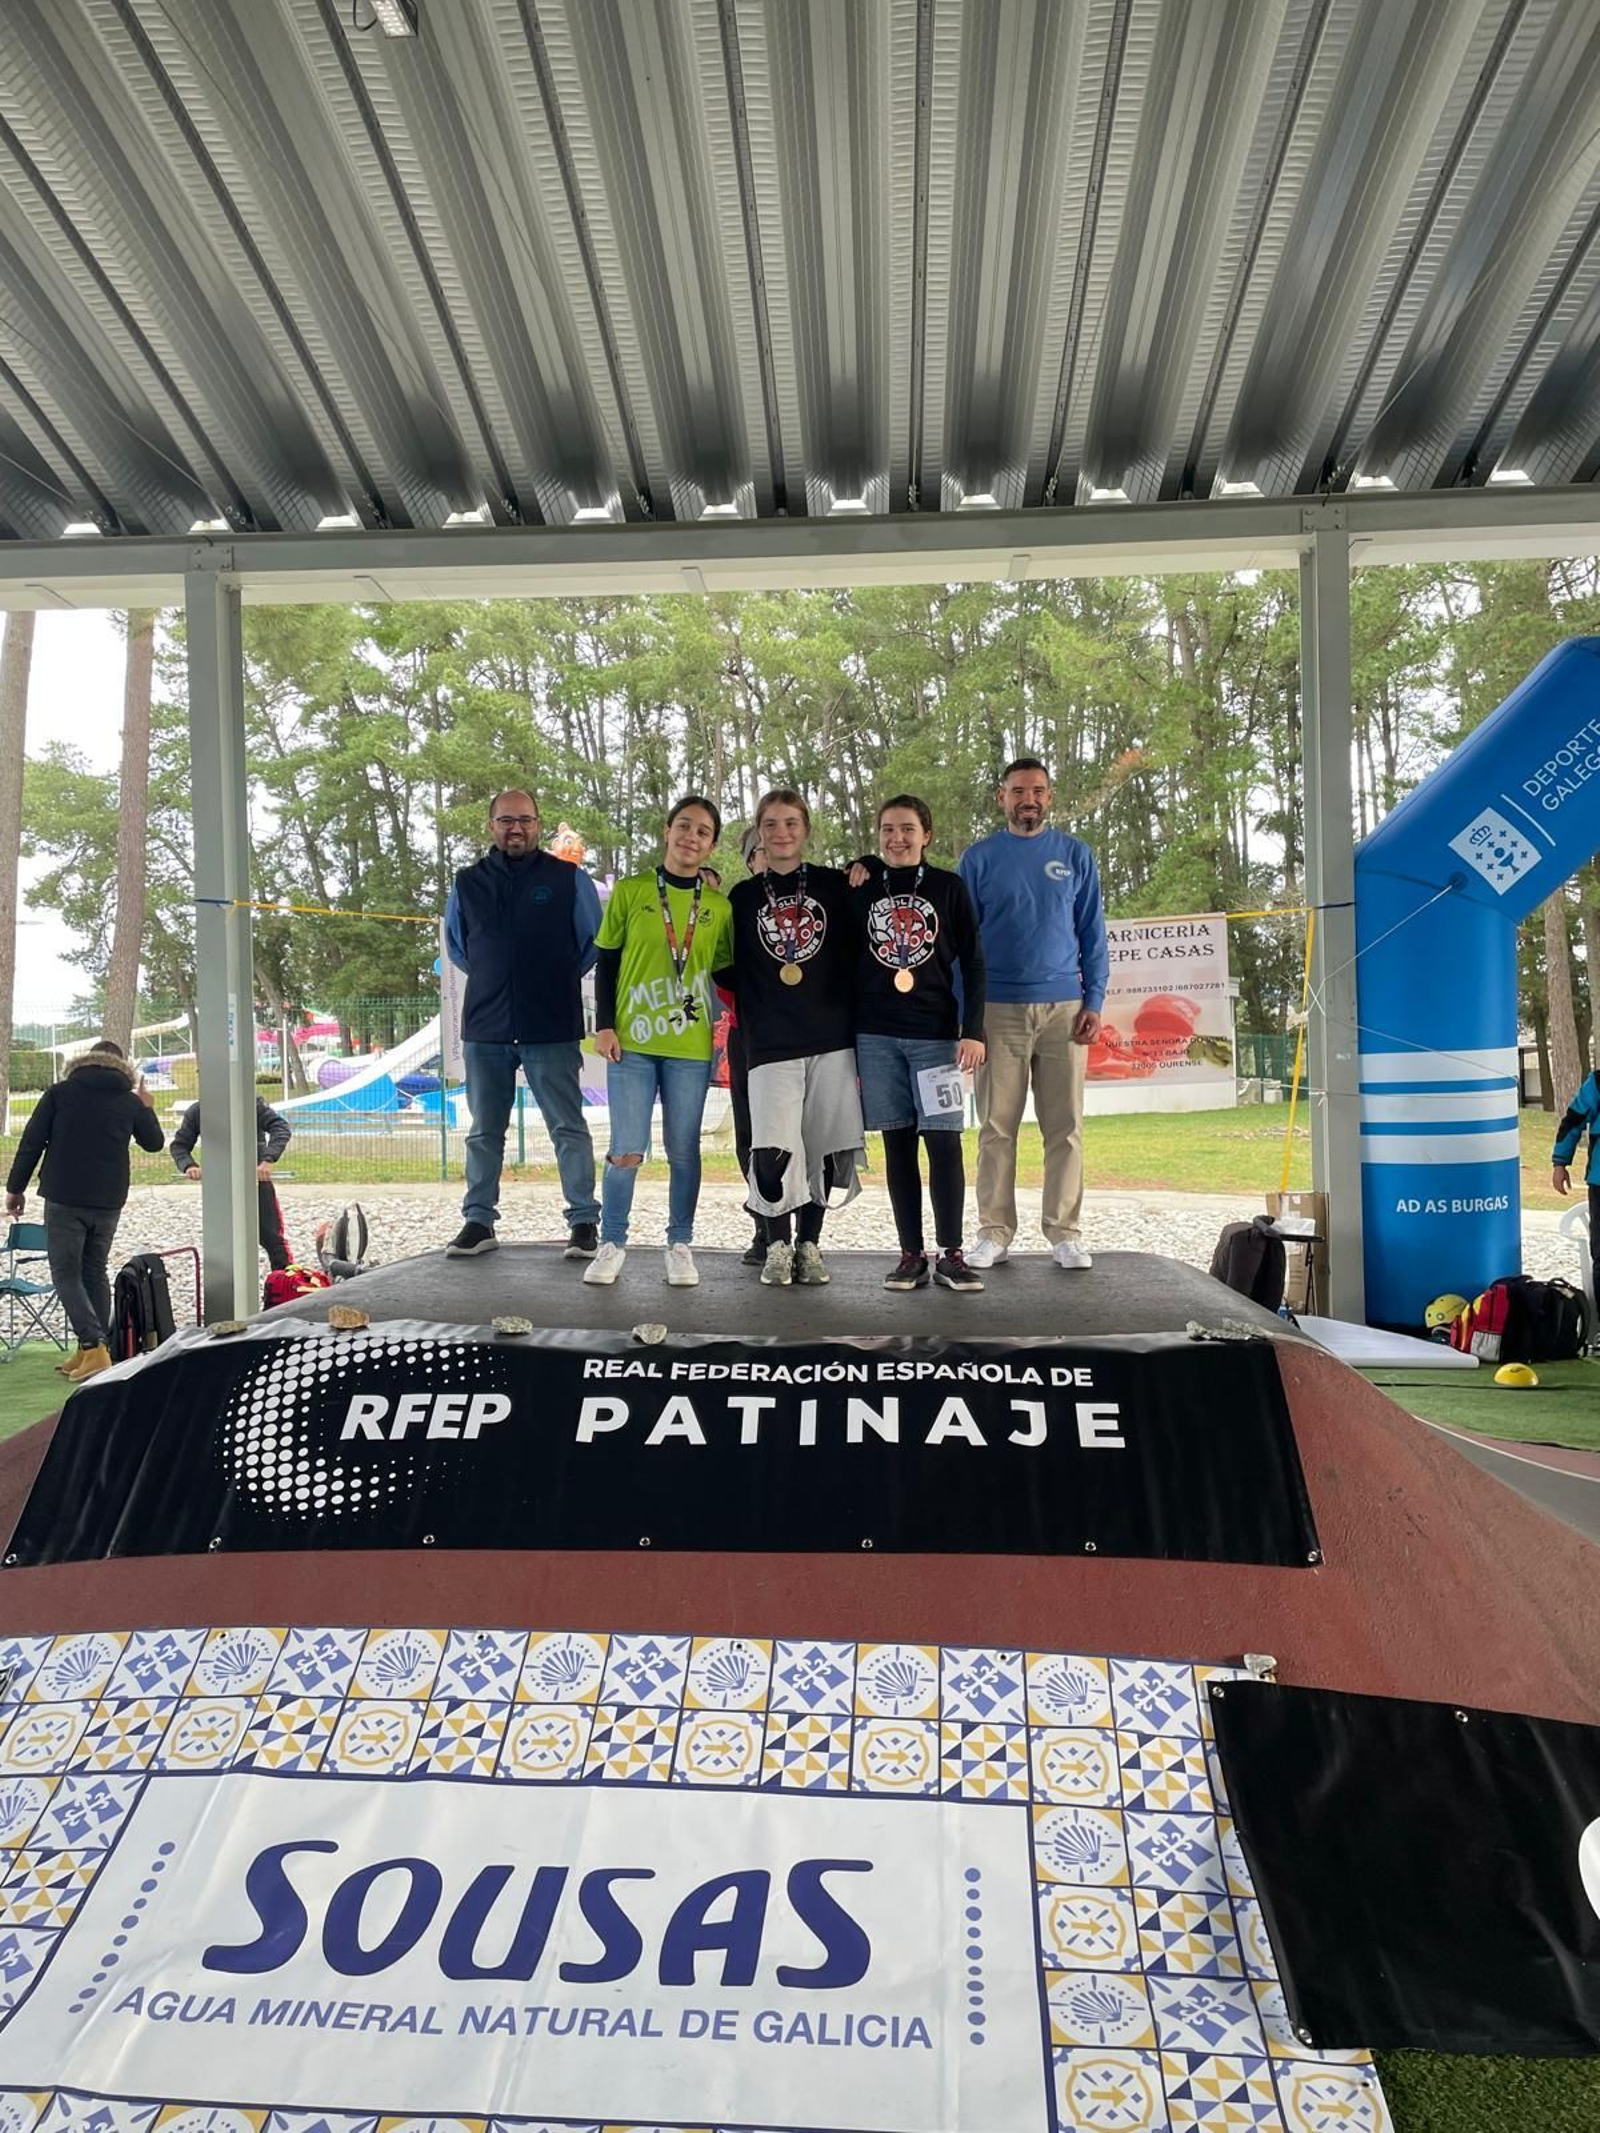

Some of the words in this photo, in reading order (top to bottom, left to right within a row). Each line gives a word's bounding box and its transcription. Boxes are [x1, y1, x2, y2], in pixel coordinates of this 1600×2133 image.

[1522, 718, 1600, 797] DEPORTE
[1541, 745, 1600, 811] GALEG
[1107, 949, 1142, 962] EPE
[1147, 943, 1215, 959] CASAS
[1159, 1059, 1203, 1069] OURENSE
[936, 1081, 963, 1109] 50
[1397, 1199, 1421, 1213] AD
[1425, 1199, 1447, 1213] AS
[1452, 1195, 1509, 1213] BURGAS
[583, 1358, 663, 1379] REAL
[670, 1360, 869, 1385] FEDERACIÓN
[876, 1361, 1045, 1386] ESPAÑOLA
[1050, 1367, 1094, 1387] DE
[339, 1393, 512, 1441] RFEP
[575, 1395, 1126, 1449] PATINAJE
[201, 1840, 874, 1989] SOUSAS
[112, 1986, 236, 2024] AGUA
[247, 1998, 443, 2035] MINERAL
[457, 2005, 664, 2038] NATURAL
[678, 2009, 740, 2041] DE
[753, 2010, 933, 2049] GALICIA
